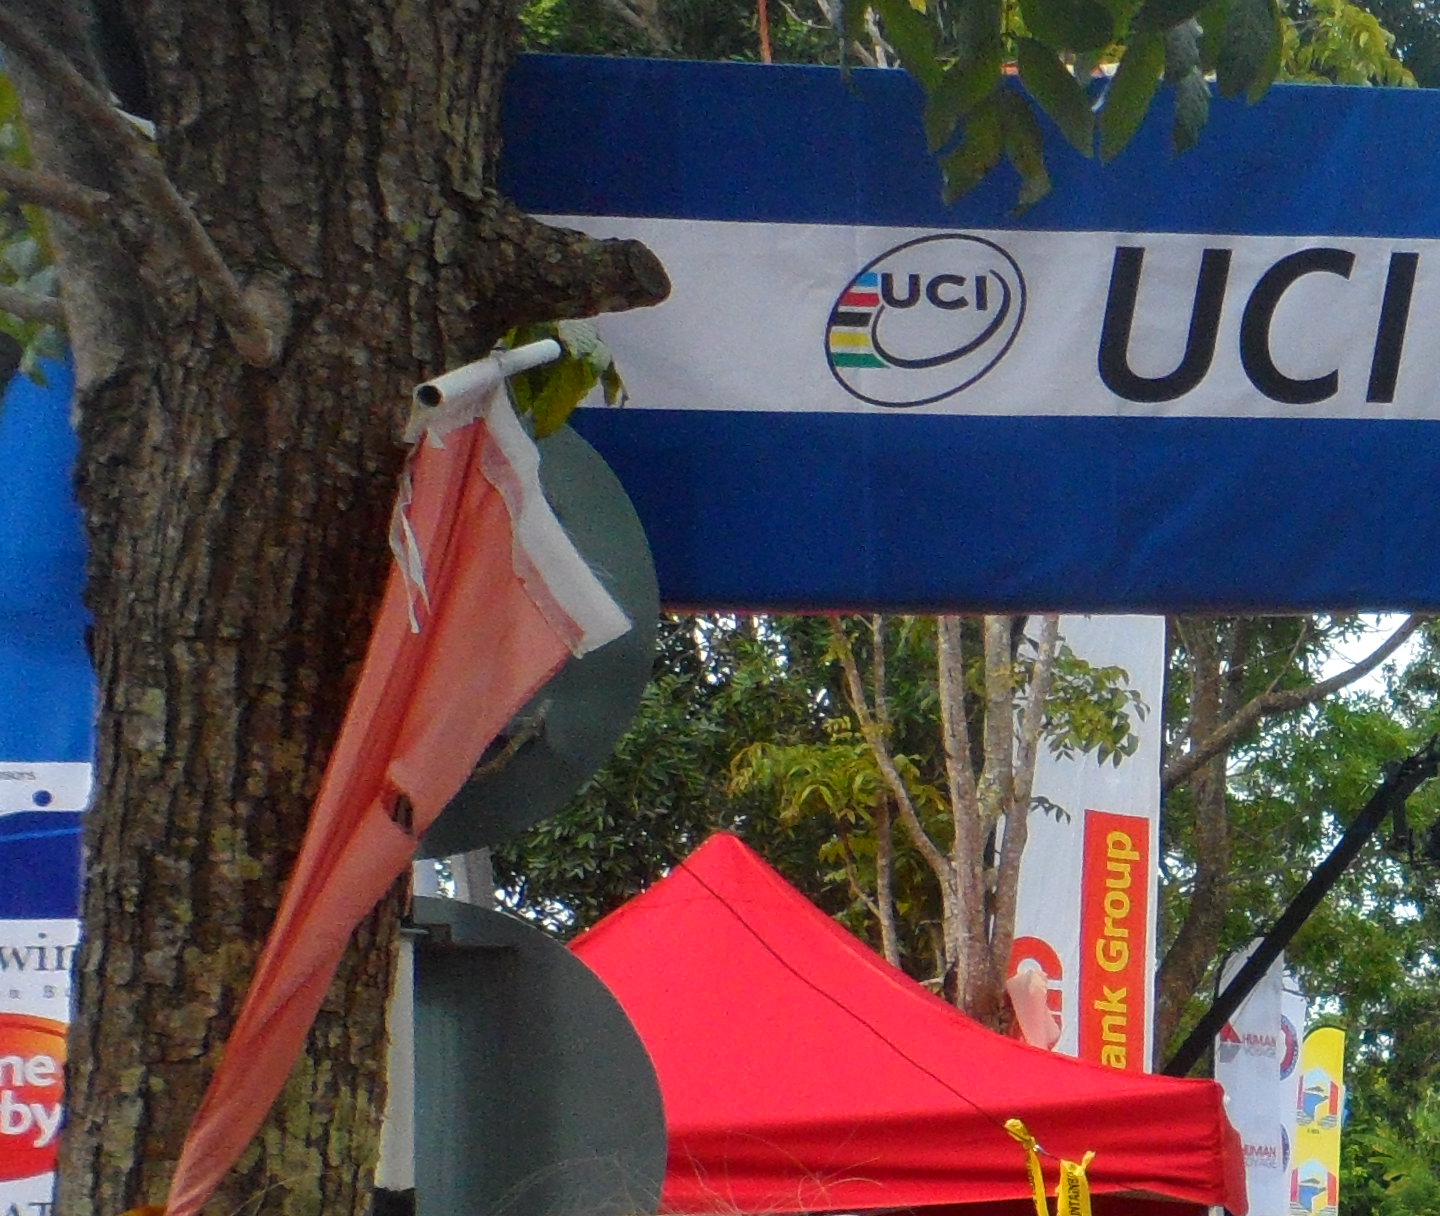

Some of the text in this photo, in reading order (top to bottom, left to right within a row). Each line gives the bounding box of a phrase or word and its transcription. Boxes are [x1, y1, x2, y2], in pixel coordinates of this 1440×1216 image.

[880, 271, 990, 311] UCI
[1098, 245, 1420, 405] UCI
[1094, 830, 1140, 1069] ank Group
